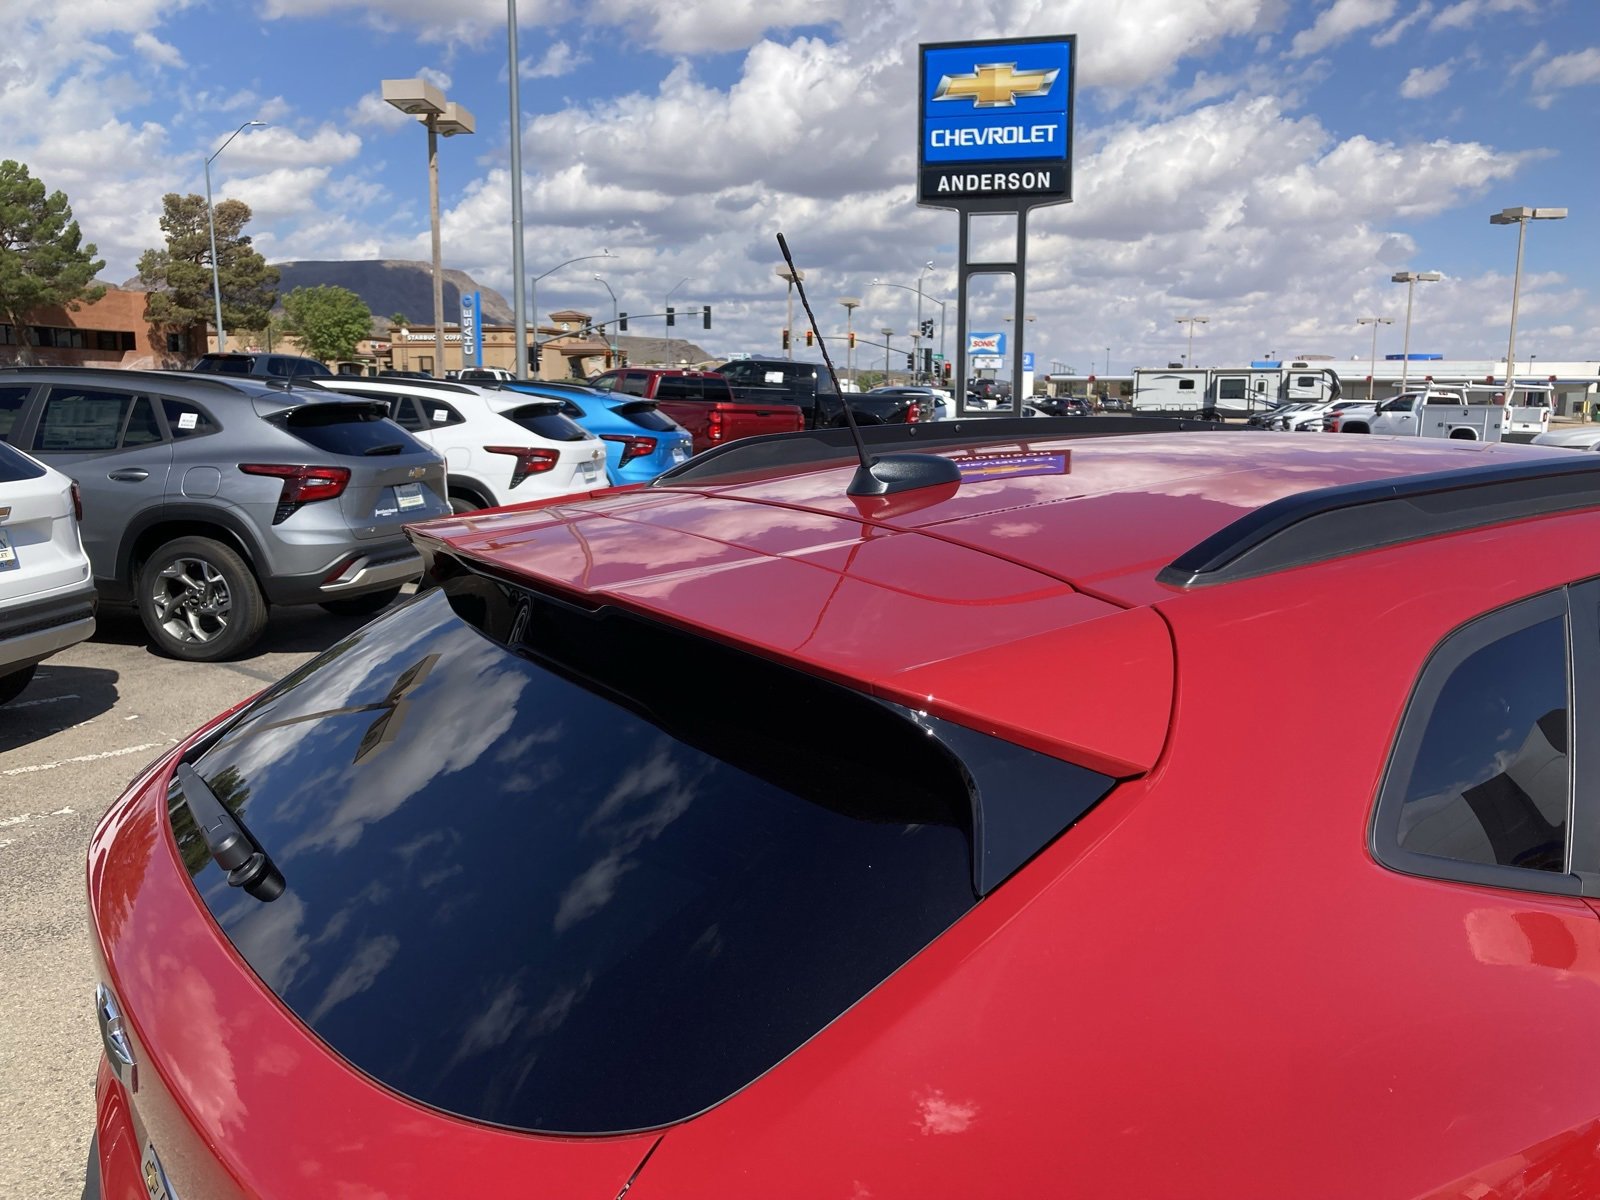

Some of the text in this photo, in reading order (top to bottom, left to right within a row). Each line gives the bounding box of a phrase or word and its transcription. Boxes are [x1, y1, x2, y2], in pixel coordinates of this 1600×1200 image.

[931, 124, 1058, 147] CHEVROLET
[937, 171, 1051, 192] ANDERSON
[463, 308, 474, 355] CHASE
[972, 340, 996, 348] SONIC
